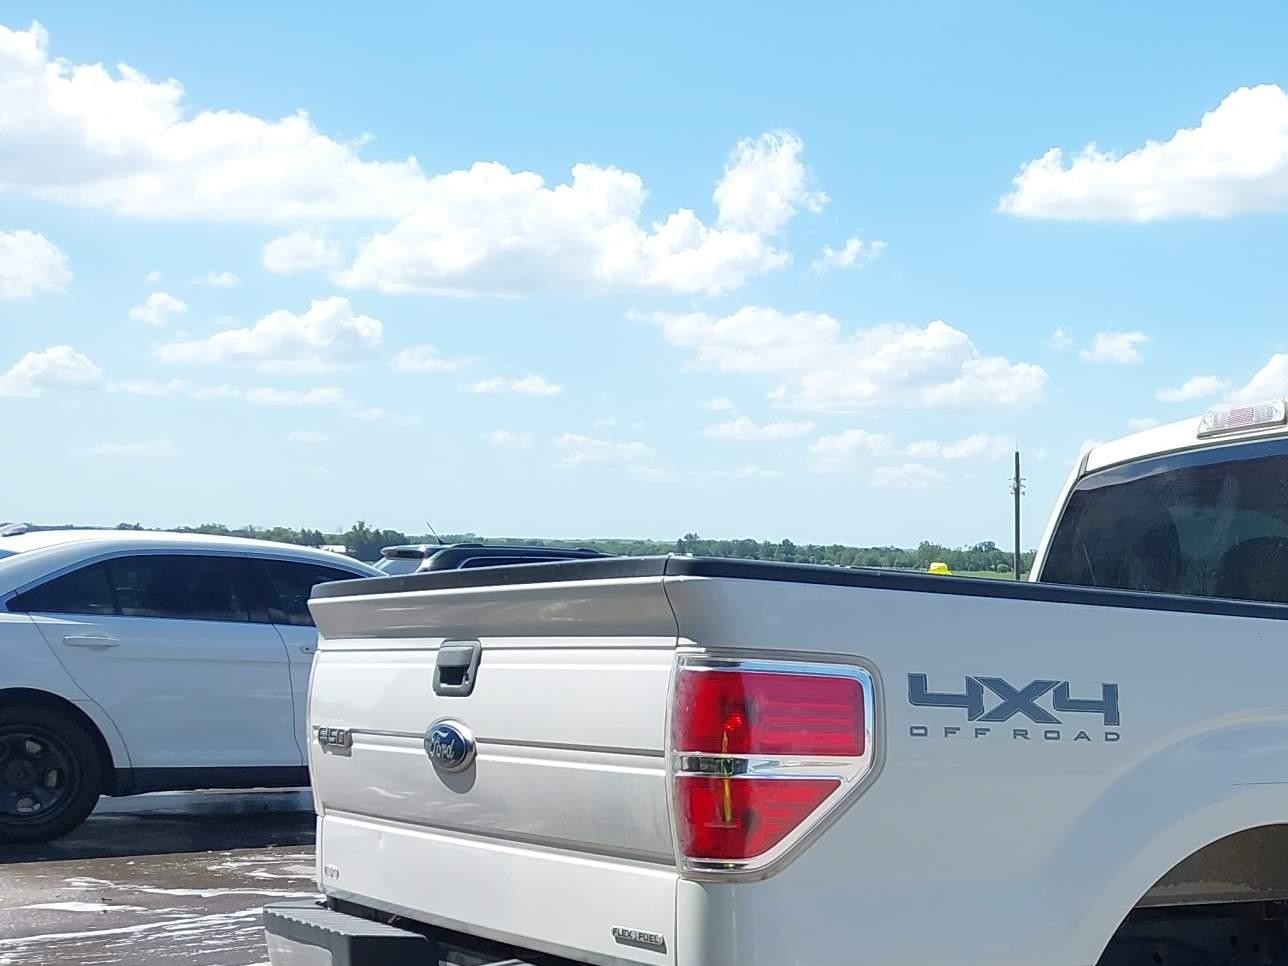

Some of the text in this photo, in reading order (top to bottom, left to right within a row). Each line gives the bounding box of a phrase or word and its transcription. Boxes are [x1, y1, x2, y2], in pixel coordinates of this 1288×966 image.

[907, 672, 1120, 726] 4X4
[430, 730, 455, 760] Ford
[612, 927, 659, 944] FLEX FUEL
